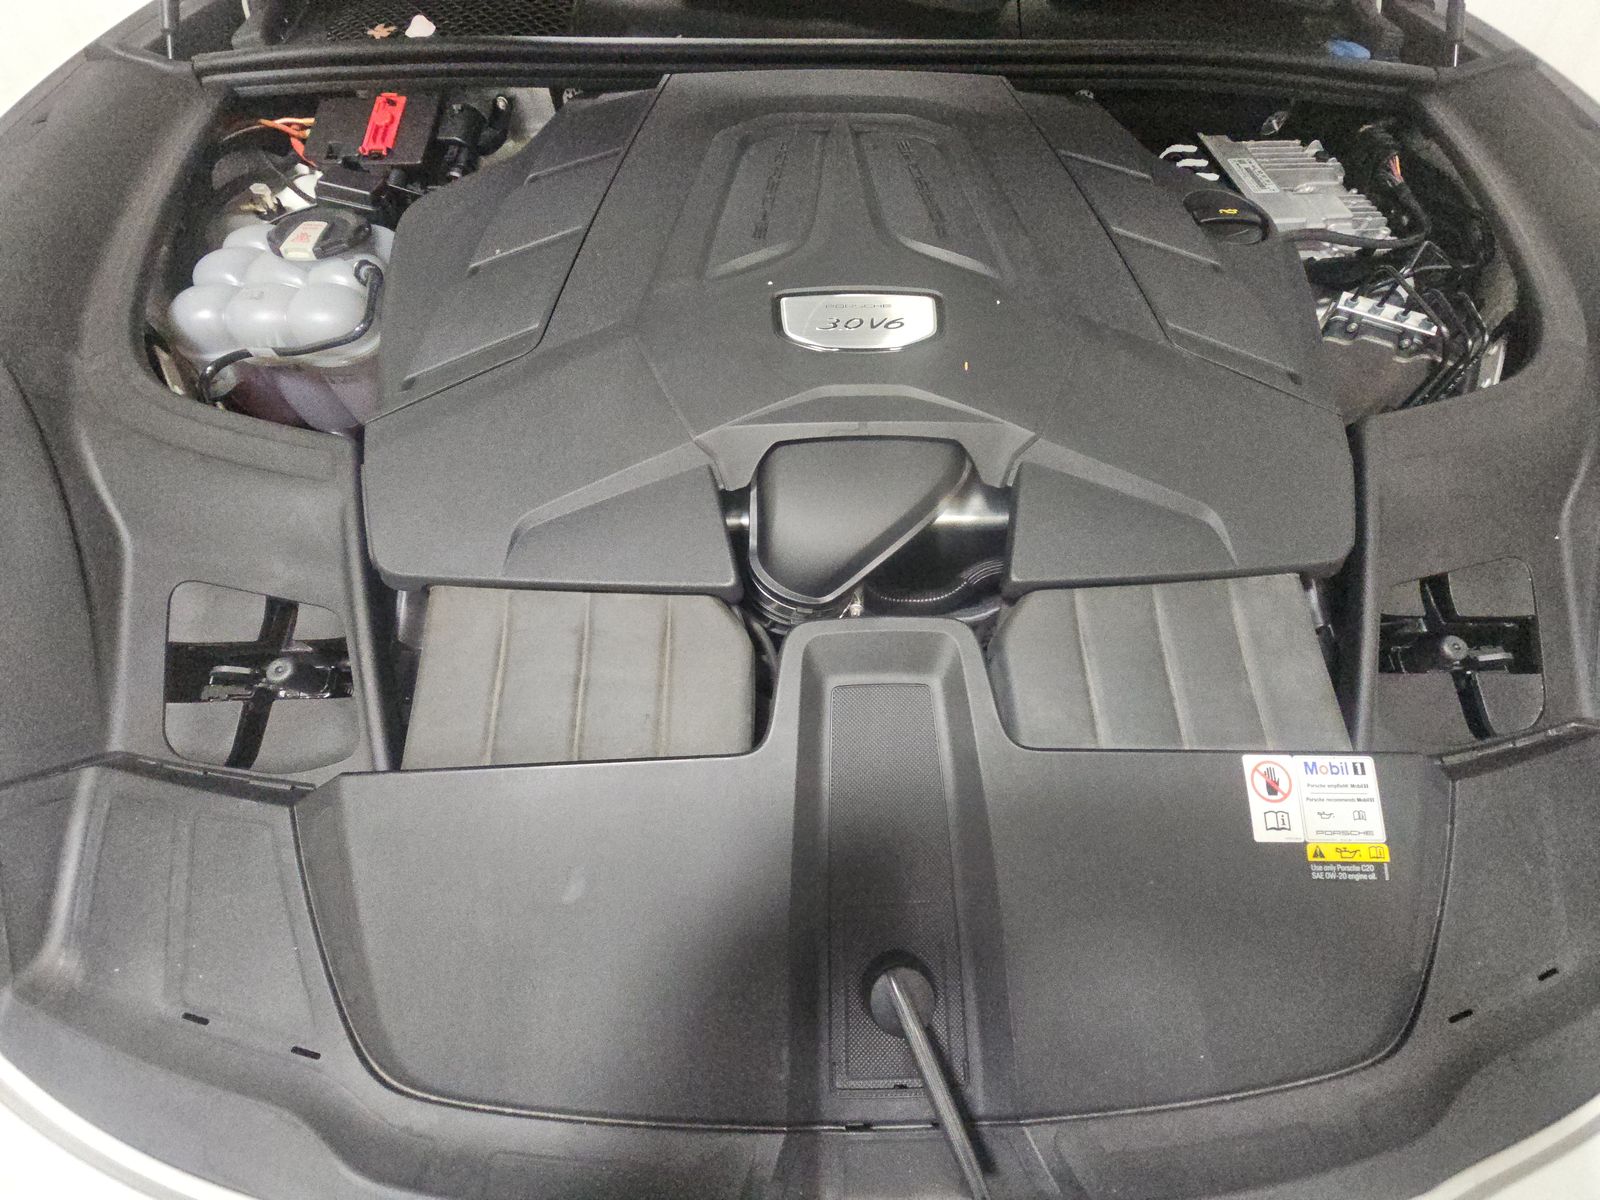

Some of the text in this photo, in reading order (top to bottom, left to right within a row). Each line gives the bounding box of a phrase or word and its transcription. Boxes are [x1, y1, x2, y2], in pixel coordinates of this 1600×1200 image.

[870, 317, 905, 330] V6
[1303, 761, 1367, 776] Mobil 1
[1310, 864, 1375, 874] Use only Porsche C20
[1311, 872, 1325, 880] SAE
[1347, 873, 1366, 882] engine
